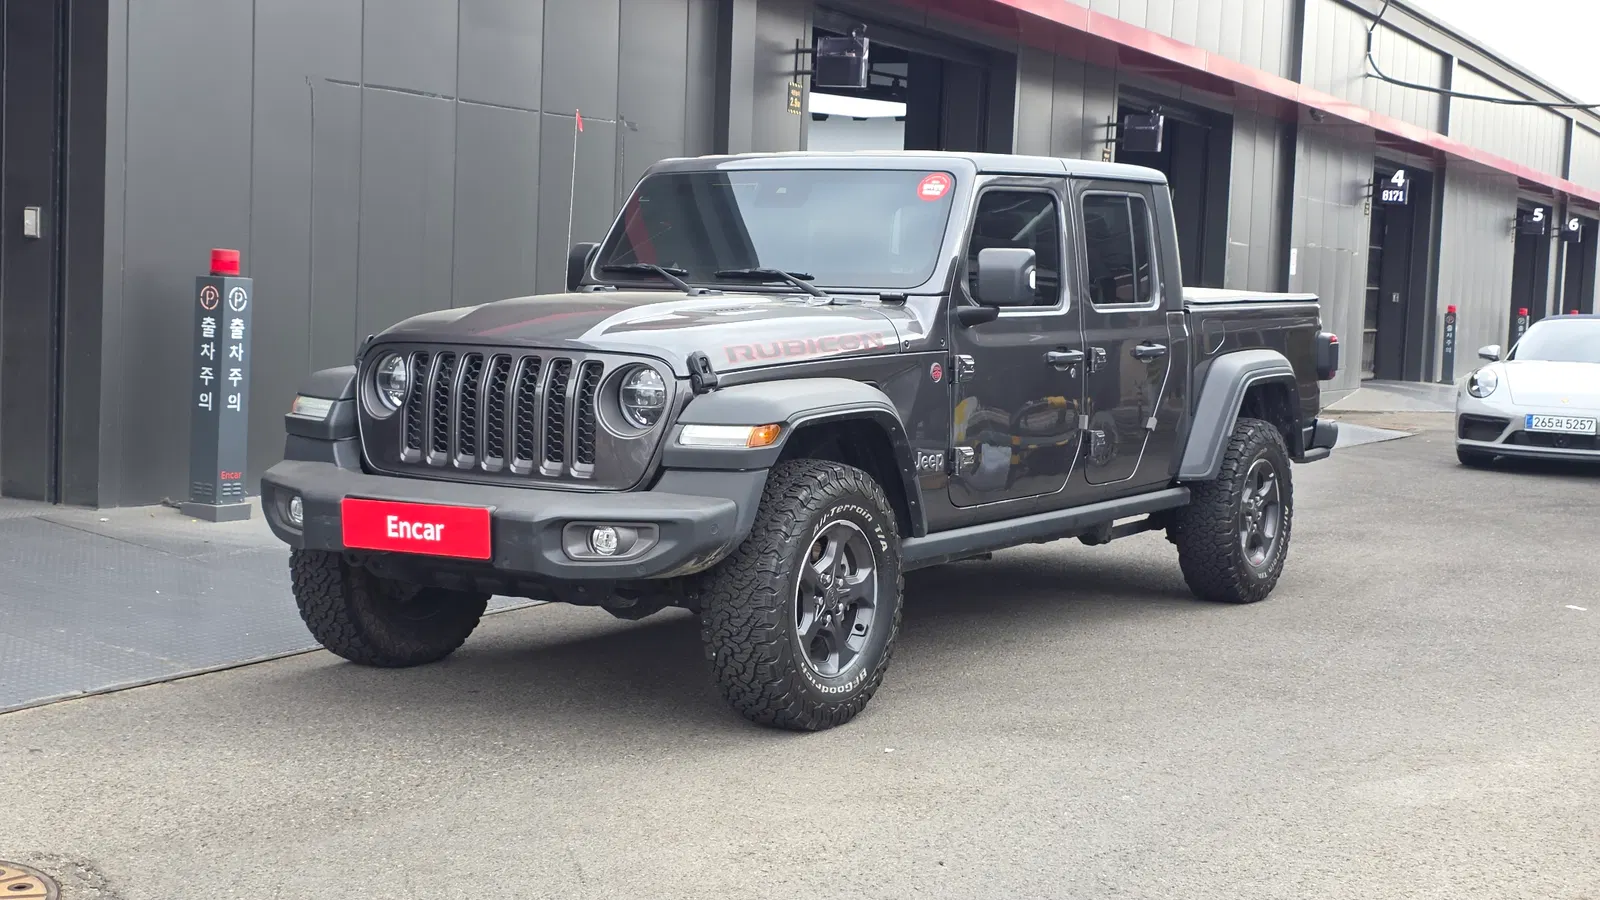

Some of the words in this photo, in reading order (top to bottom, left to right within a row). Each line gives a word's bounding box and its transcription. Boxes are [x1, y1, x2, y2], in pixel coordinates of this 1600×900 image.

[1390, 170, 1405, 187] 4
[1382, 189, 1404, 202] 8171
[1532, 207, 1544, 222] 5
[1568, 217, 1579, 231] 6
[724, 332, 886, 363] RUBICON
[1566, 418, 1594, 431] 5257
[914, 451, 944, 472] Jeep
[220, 470, 242, 480] Encar
[386, 514, 445, 542] Encar
[799, 661, 868, 695] BFGoodrich
